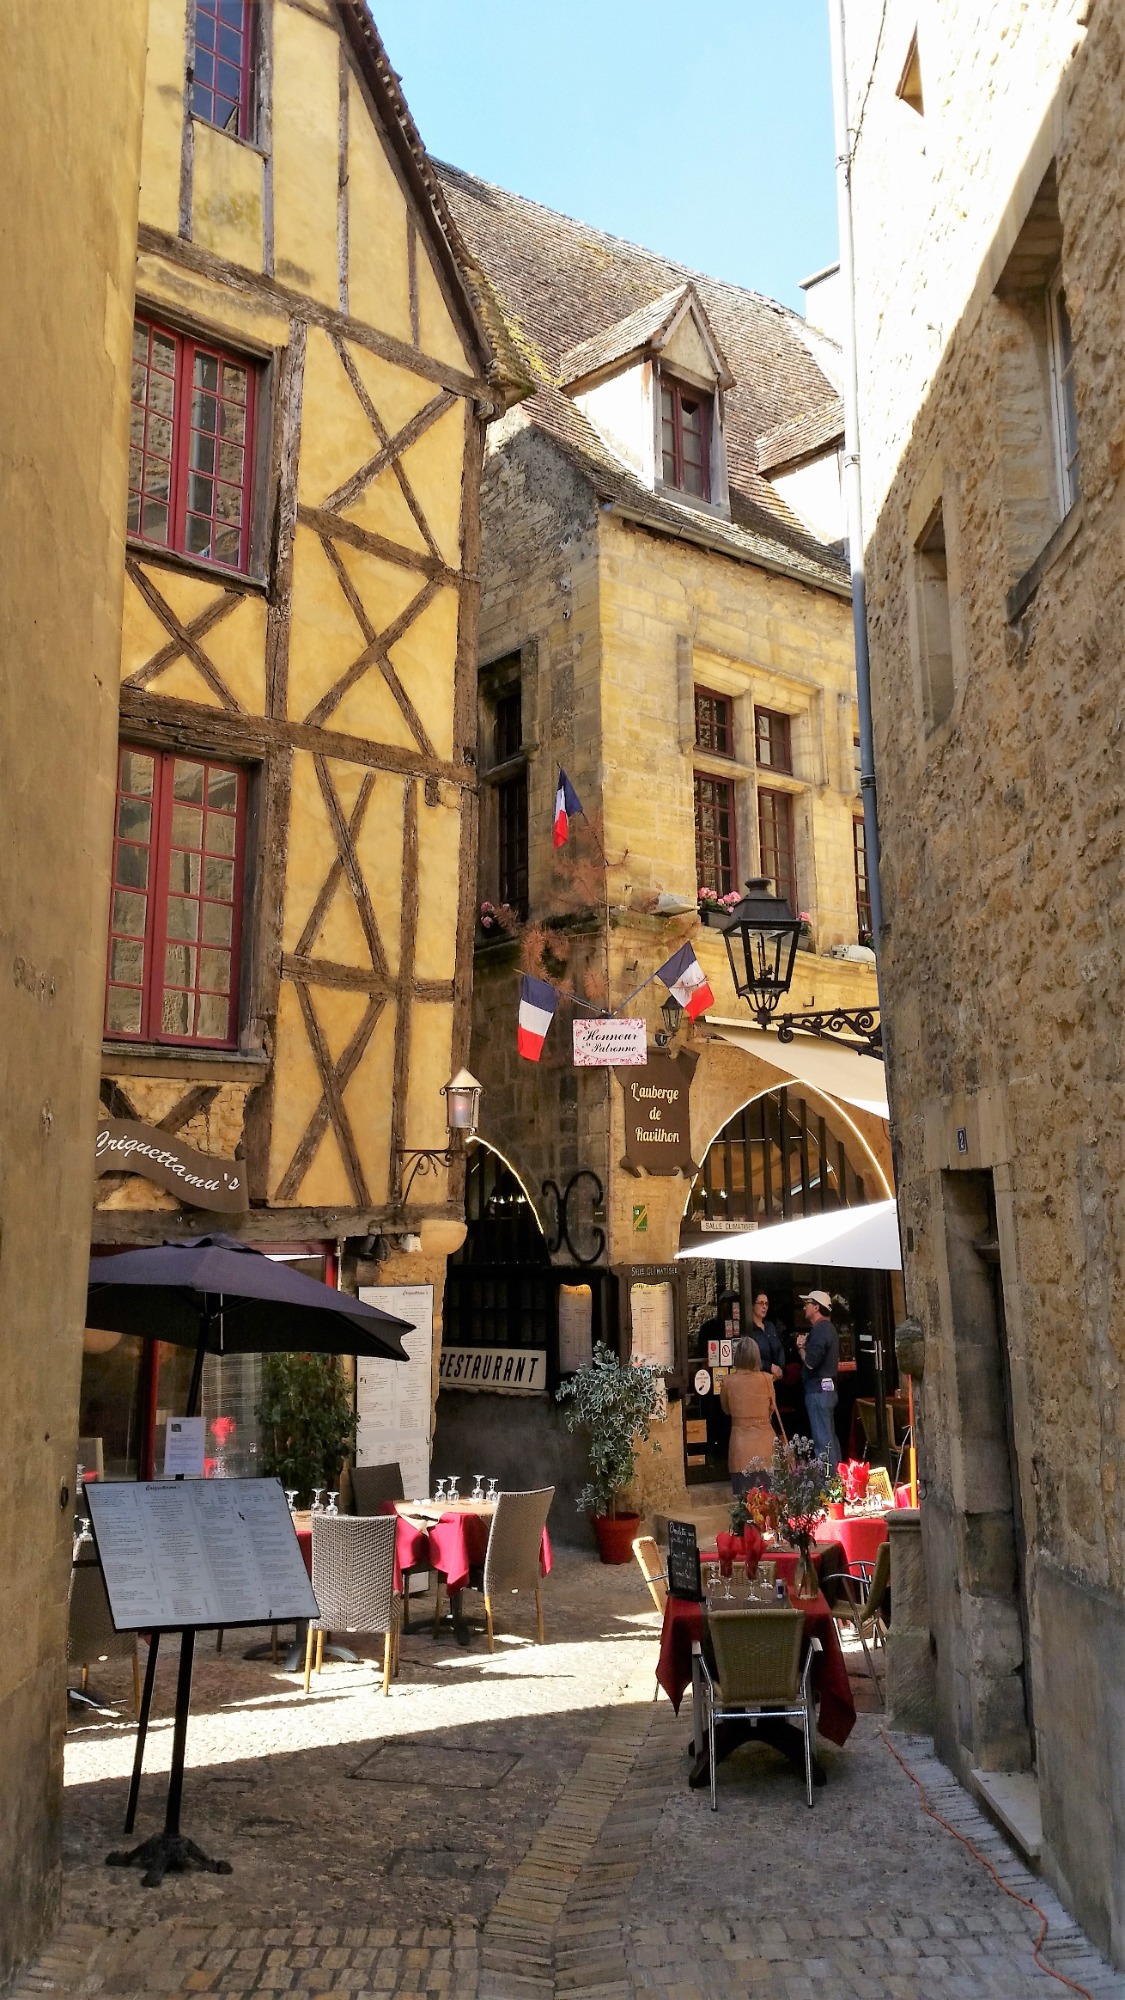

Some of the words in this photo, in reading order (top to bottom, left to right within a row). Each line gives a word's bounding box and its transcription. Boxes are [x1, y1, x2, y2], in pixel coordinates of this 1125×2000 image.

[583, 1029, 638, 1042] Honneur
[630, 1082, 679, 1104] L'auberge
[649, 1106, 662, 1121] de
[635, 1126, 680, 1143] Ravilhon
[705, 1222, 723, 1230] SALLE
[439, 1353, 540, 1383] RESTAURANT
